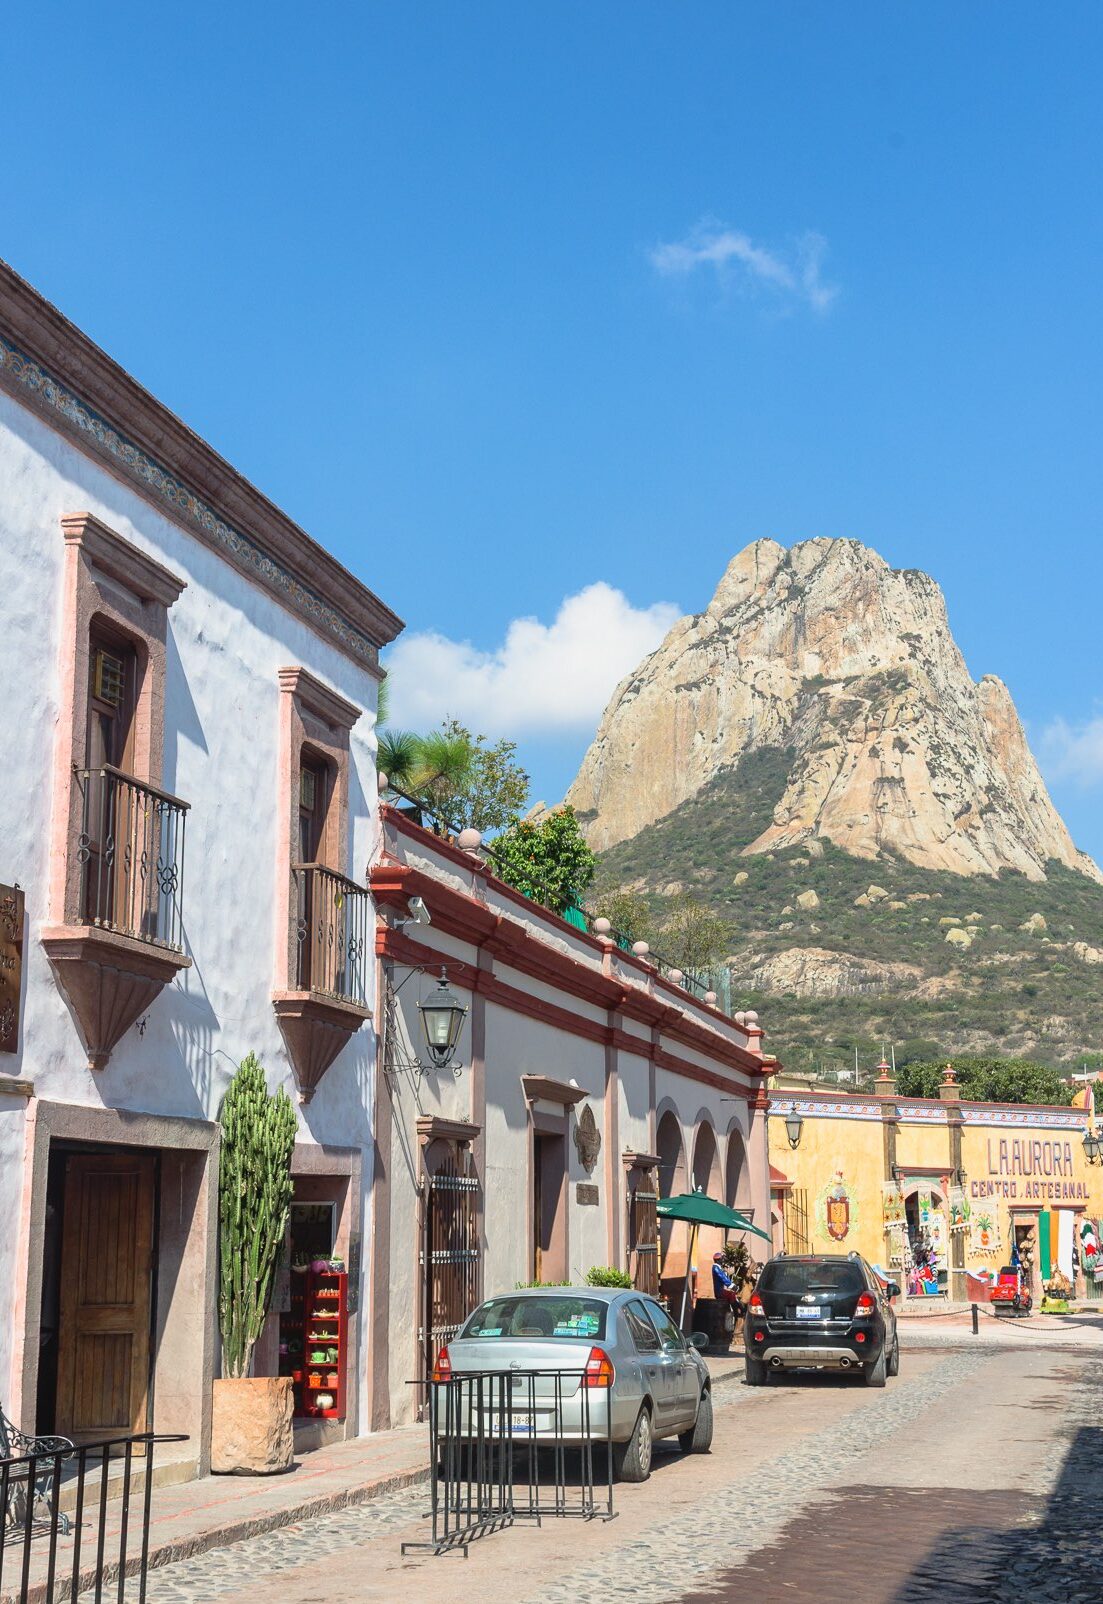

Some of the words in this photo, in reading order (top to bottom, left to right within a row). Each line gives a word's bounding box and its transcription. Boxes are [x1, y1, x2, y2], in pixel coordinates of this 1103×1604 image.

[988, 1138, 1009, 1175] LA
[1012, 1138, 1073, 1177] AURORA
[971, 1180, 1017, 1198] CENTRO
[1025, 1180, 1090, 1199] ARTESANAL
